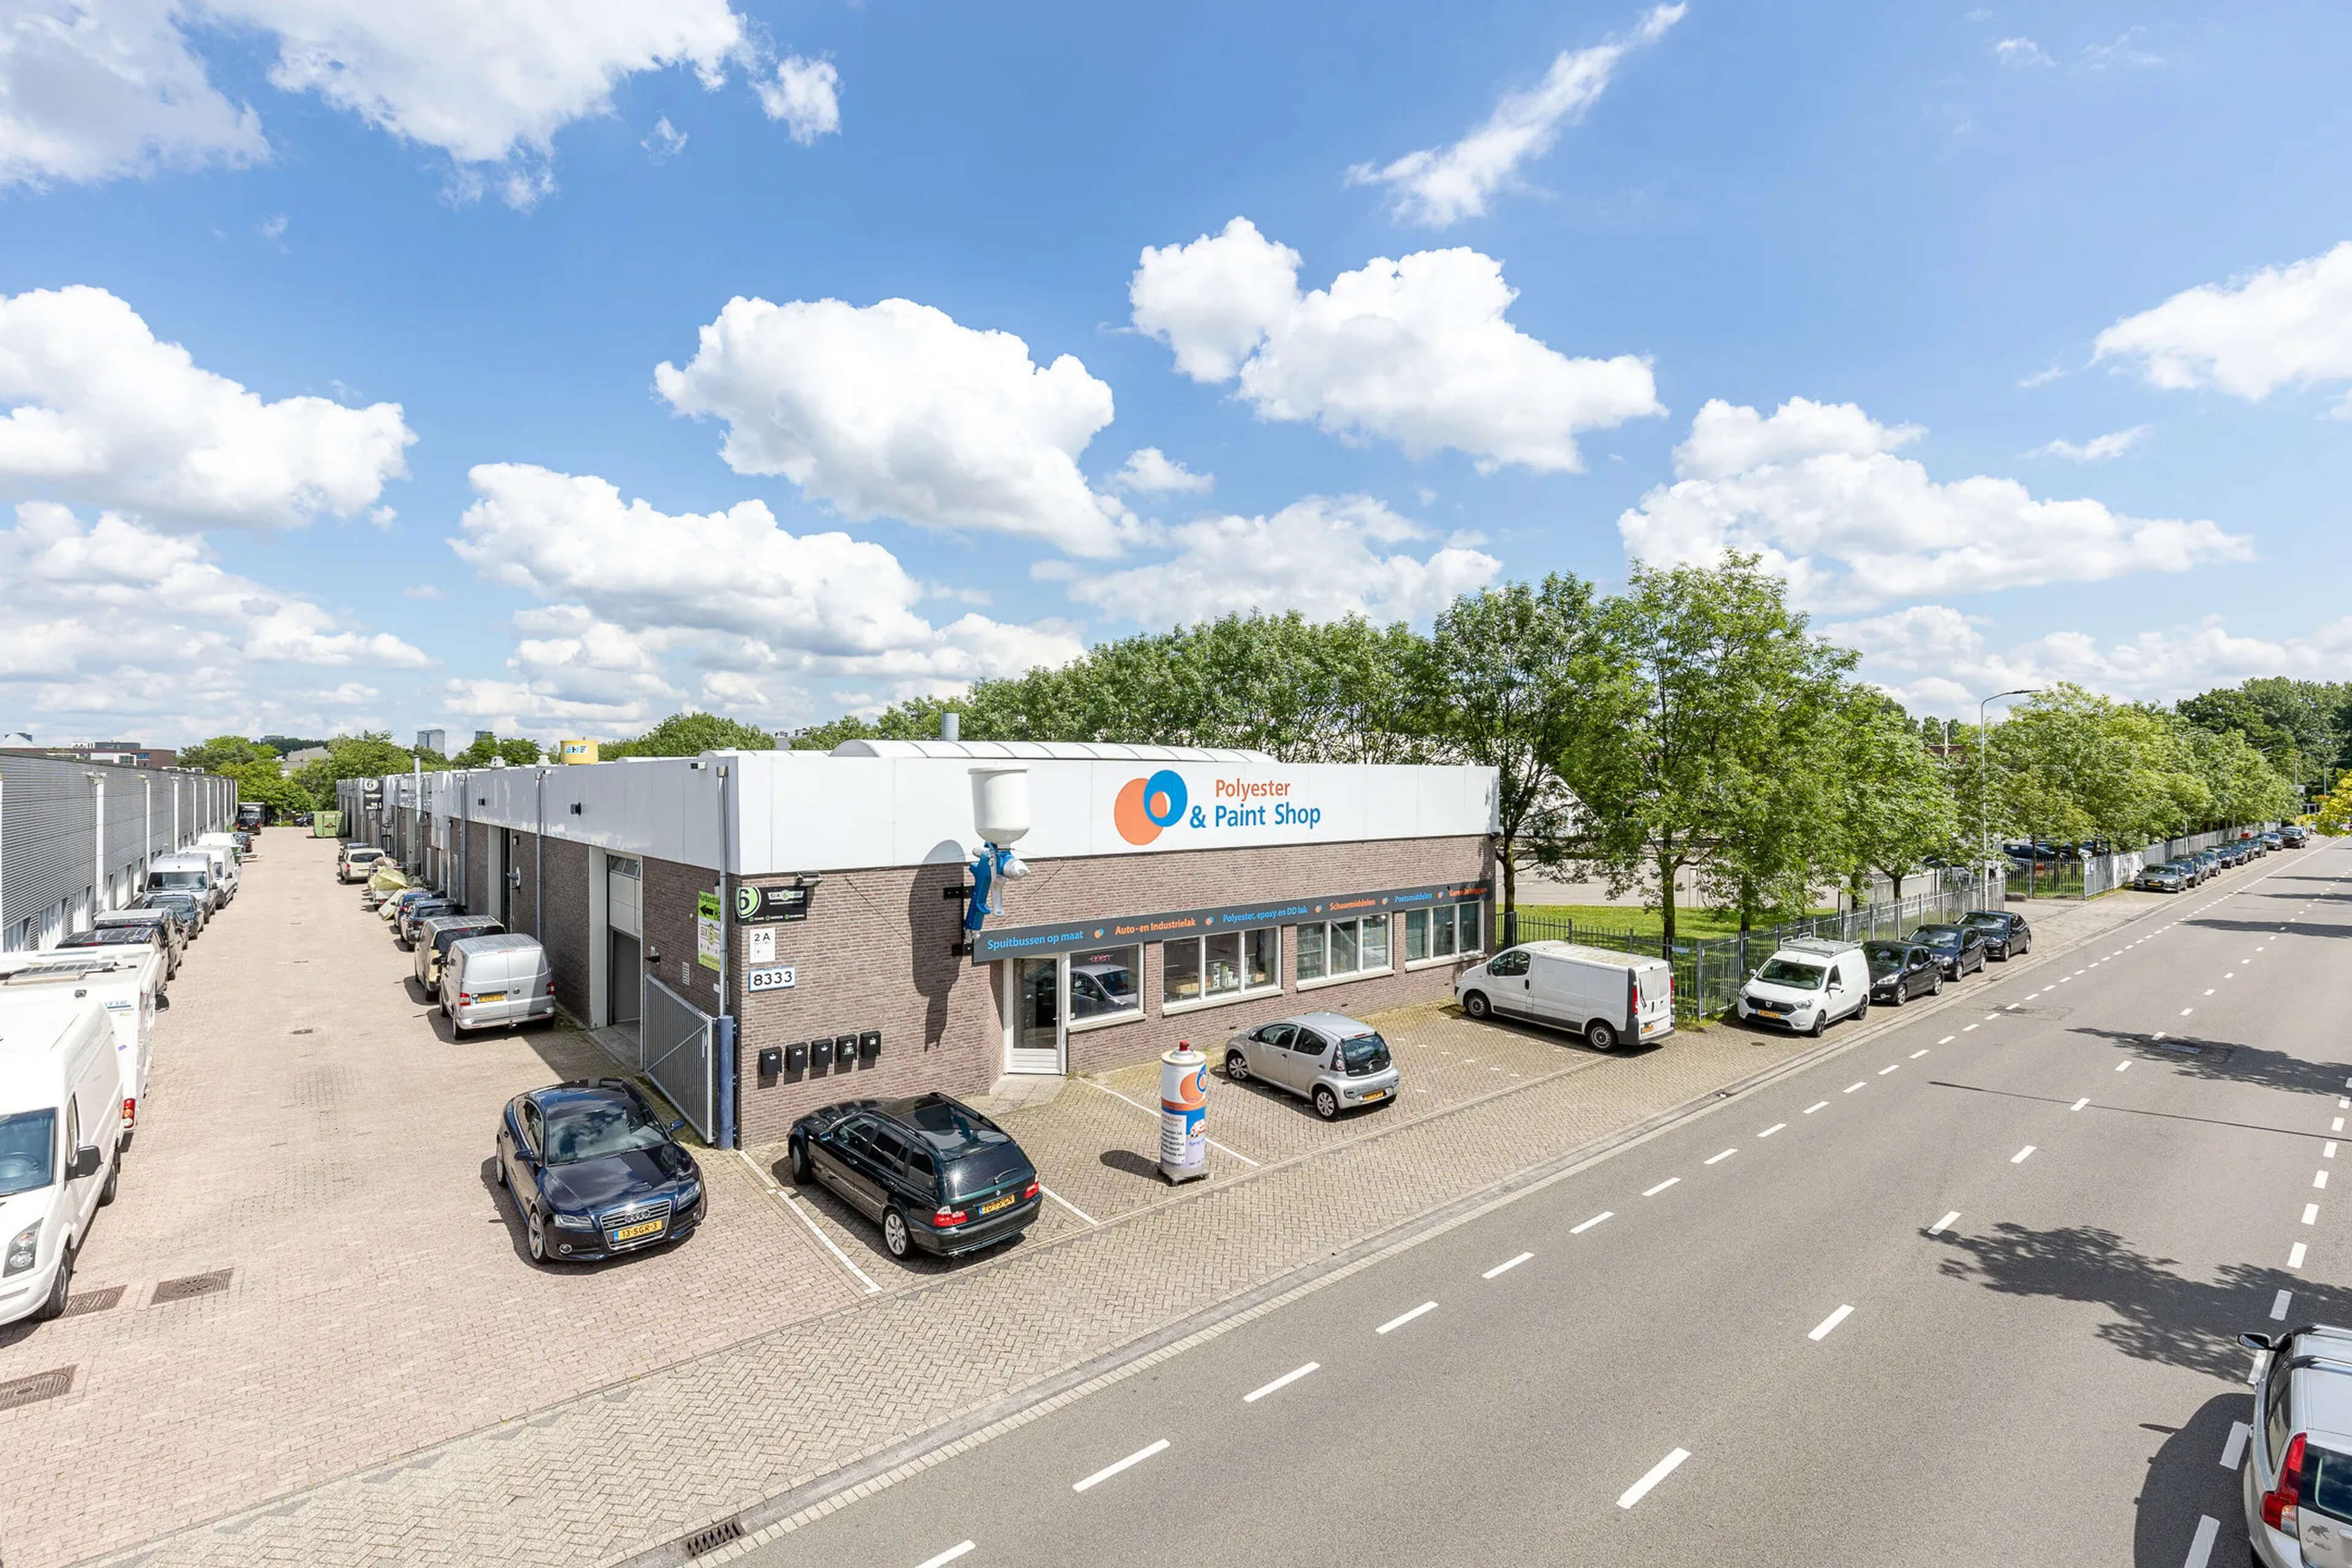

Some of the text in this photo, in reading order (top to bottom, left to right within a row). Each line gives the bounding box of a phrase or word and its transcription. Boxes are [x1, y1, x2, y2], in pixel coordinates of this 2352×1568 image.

[1215, 778, 1291, 802] Polyester
[1189, 801, 1321, 829] & Paint Shop
[739, 888, 750, 911] 6
[1256, 910, 1277, 921] epoxy
[1287, 907, 1297, 916] DD
[1298, 905, 1308, 914] lak
[1150, 918, 1196, 931] Industrielak
[987, 930, 1084, 951] Spuitbussen op maat
[753, 971, 793, 986] 8333
